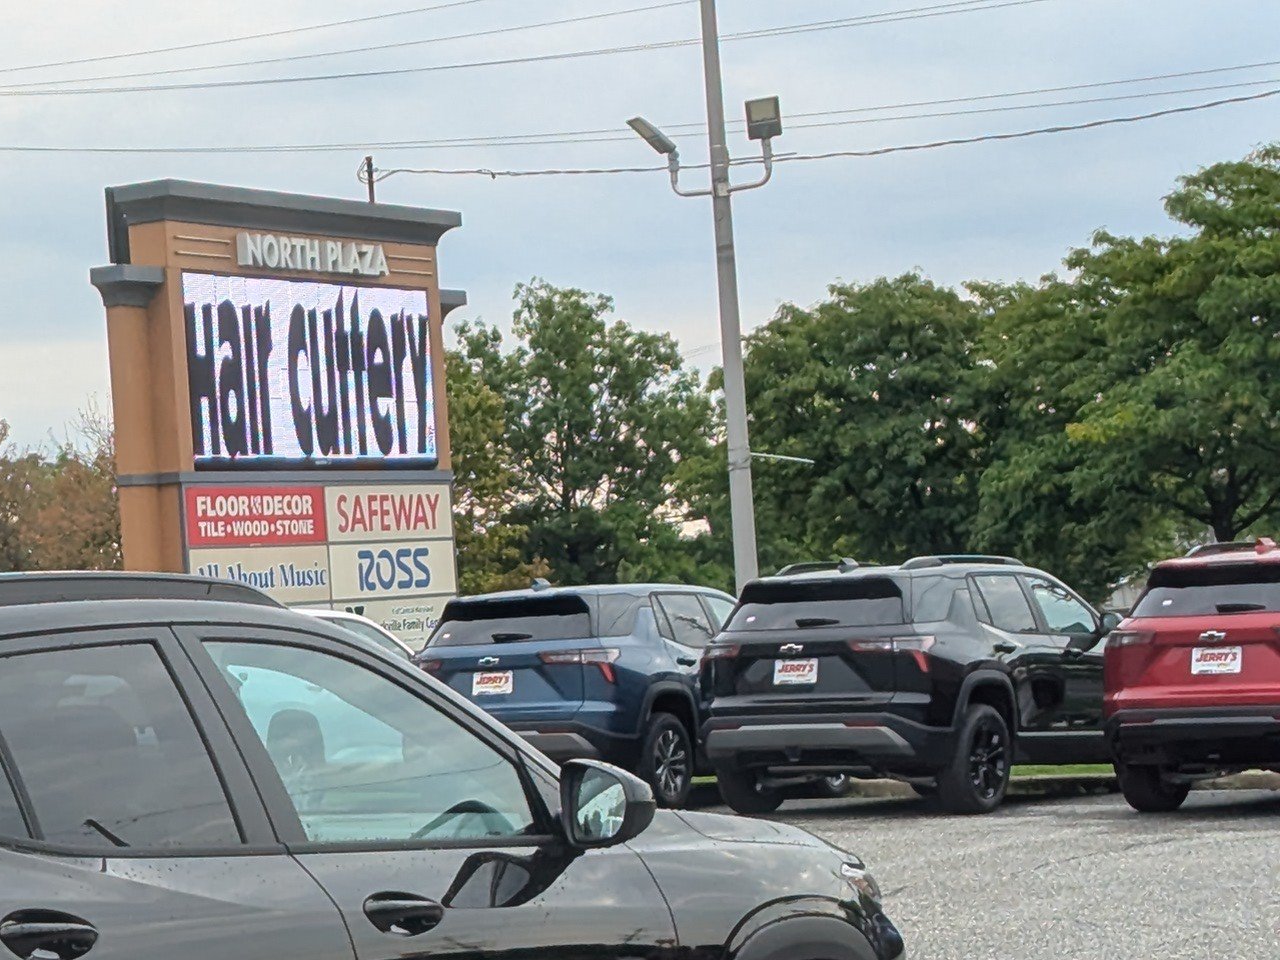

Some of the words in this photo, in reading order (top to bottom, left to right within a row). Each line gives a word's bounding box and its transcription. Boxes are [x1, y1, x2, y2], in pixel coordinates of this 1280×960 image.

[237, 231, 320, 272] NORTH
[326, 240, 390, 276] PLAZA
[183, 298, 272, 458] Hair
[196, 495, 249, 517] FLOOR
[262, 494, 313, 516] DECOR
[337, 493, 440, 534] SAFEWAY
[198, 521, 226, 537] TILE
[232, 520, 269, 536] WOOD
[276, 519, 315, 536] STONE
[279, 561, 327, 588] Music
[357, 547, 431, 592] ROSS
[778, 663, 815, 673] JERRY'S
